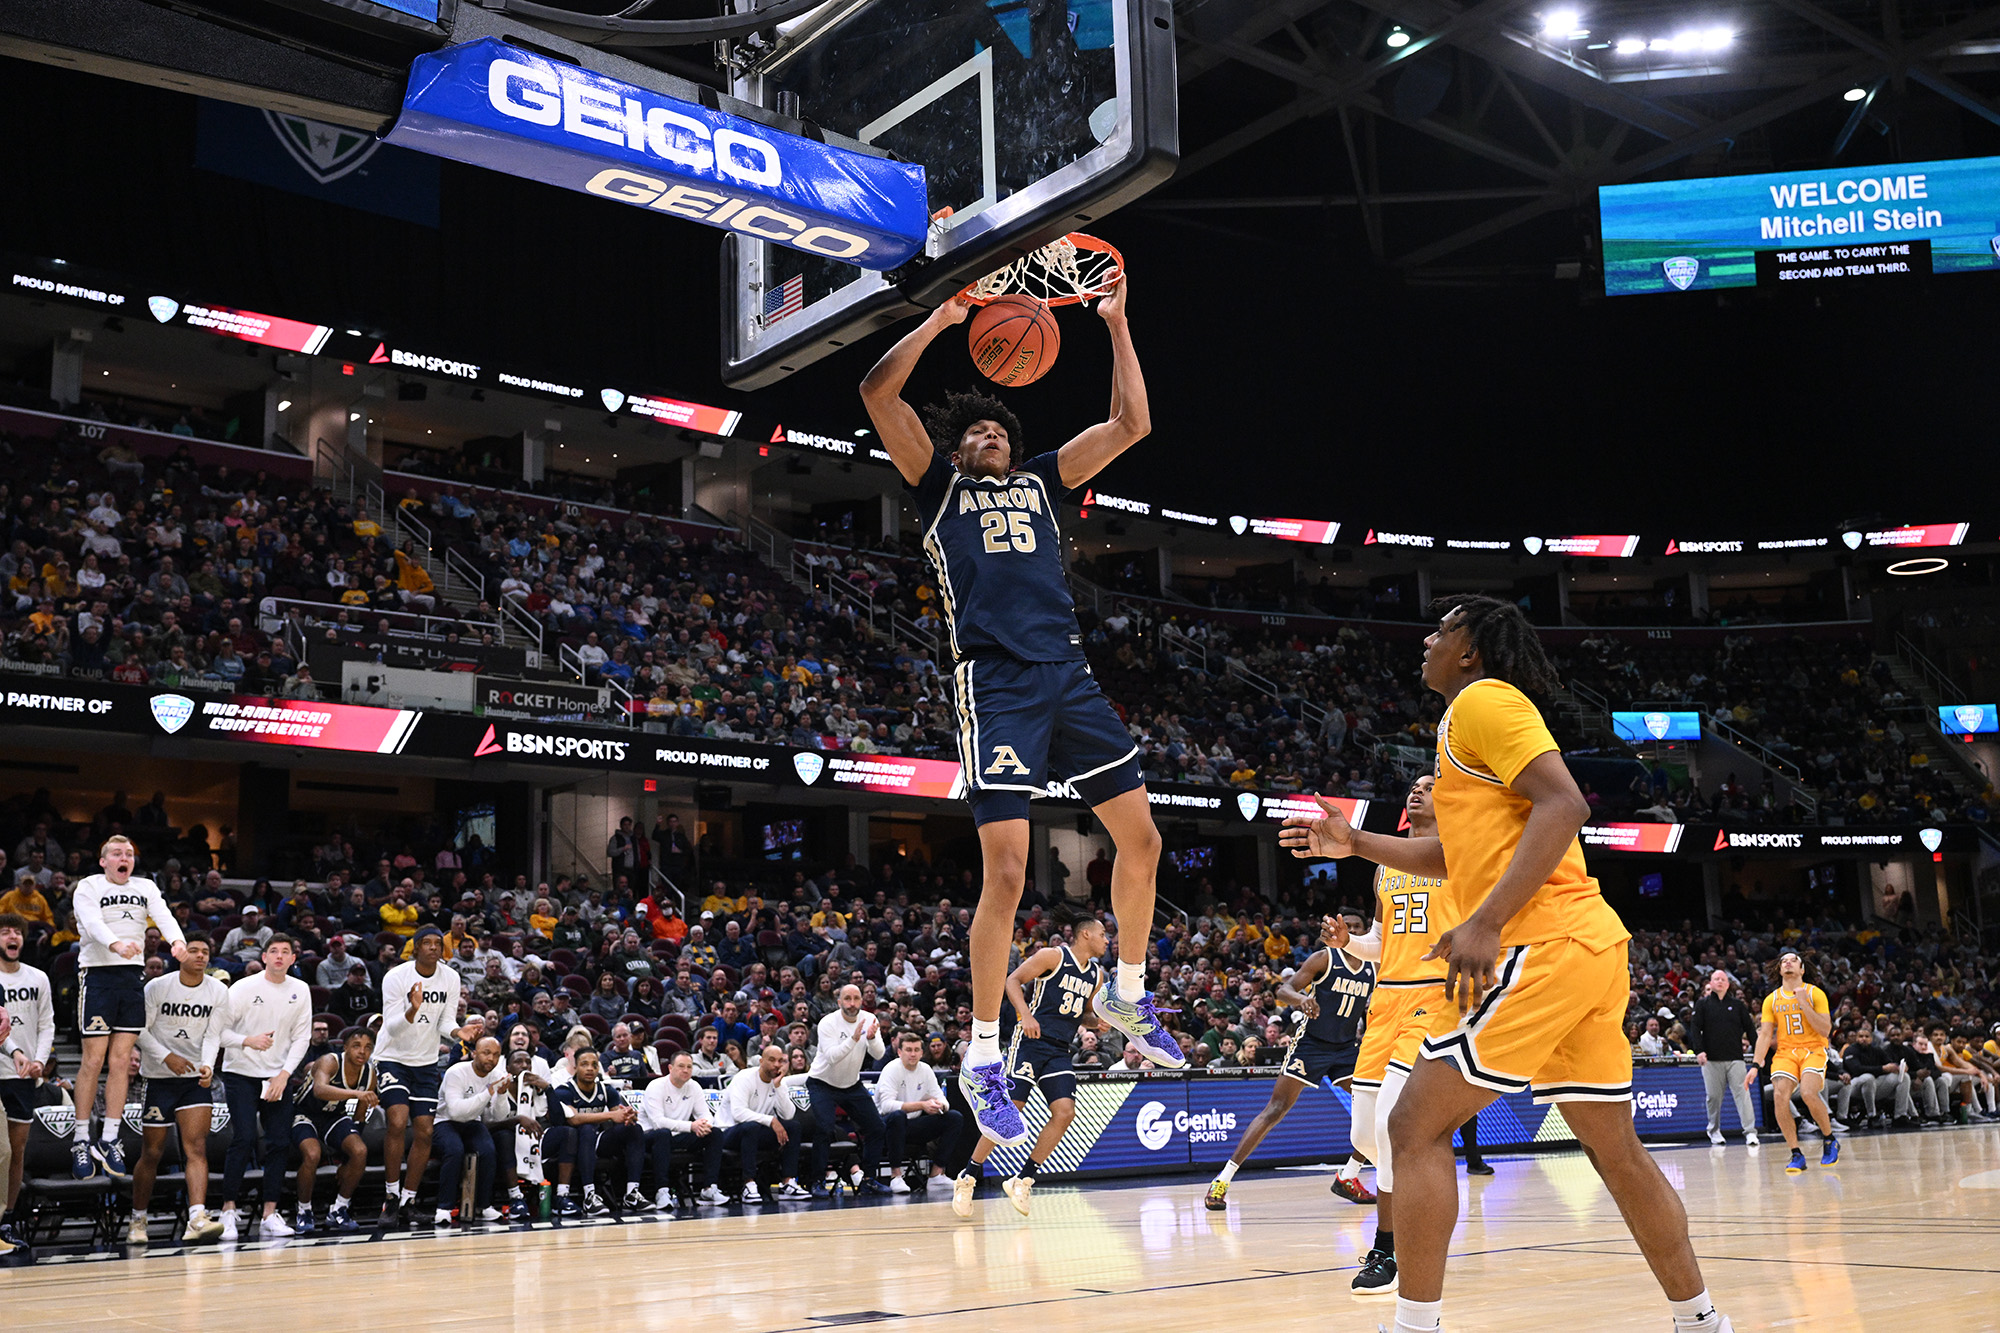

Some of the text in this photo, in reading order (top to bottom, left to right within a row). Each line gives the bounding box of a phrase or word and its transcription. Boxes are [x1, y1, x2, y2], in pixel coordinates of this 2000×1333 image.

[488, 58, 782, 188] GEICO
[1769, 175, 1928, 209] WELCOME
[585, 168, 869, 258] GEICO
[1760, 206, 1943, 240] Mitchell Stein
[1776, 244, 1910, 264] THE GAME. TO CARRY THE
[1779, 262, 1910, 281] SECOND AND TEAM THIRD.
[13, 274, 125, 305] PROUD PARTNER OF
[183, 304, 271, 330] MID-AMERICAN
[1000, 346, 1034, 386] SPALDIN
[499, 373, 584, 398] PROUD PARTNER OF
[79, 424, 107, 439] 107
[959, 487, 1042, 516] AKRON
[980, 511, 1037, 554] 25
[1758, 541, 1783, 550] PROUD
[1784, 539, 1814, 549] PARTNER
[529, 655, 536, 667] 4
[7, 692, 85, 713] PARTNER
[88, 699, 113, 714] OF
[156, 705, 189, 718] MAC
[489, 690, 605, 714] ROCKET Homes
[203, 702, 332, 725] MID-AMERICAN
[209, 717, 324, 738] CONFERENCE
[656, 749, 770, 770] PROUD PARTNER OF
[828, 758, 916, 776] MID-AMERICAN
[984, 745, 1031, 776] A
[833, 771, 911, 787] CONFERENCE
[1172, 794, 1208, 808] PARTNER
[1209, 798, 1222, 809] OF
[1821, 835, 1903, 846] PROUD PARTNER OF
[100, 894, 148, 909] AKRON
[1391, 892, 1429, 935] 33
[1058, 973, 1094, 999] AKRON
[1331, 976, 1370, 998] AKRON
[161, 1002, 213, 1018] AKRON
[1058, 991, 1085, 1019] 34
[1336, 994, 1356, 1019] 11
[85, 1015, 111, 1031] A
[1784, 1013, 1805, 1036] 13
[173, 1029, 190, 1040] A
[1018, 1060, 1036, 1079] A
[1288, 1057, 1308, 1077] A
[380, 1071, 399, 1088] A
[1637, 1090, 1679, 1109] Genius
[143, 1106, 166, 1121] A
[1174, 1108, 1237, 1133] Genius
[1646, 1108, 1673, 1119] SPORTS
[1189, 1131, 1228, 1144] SPORTS
